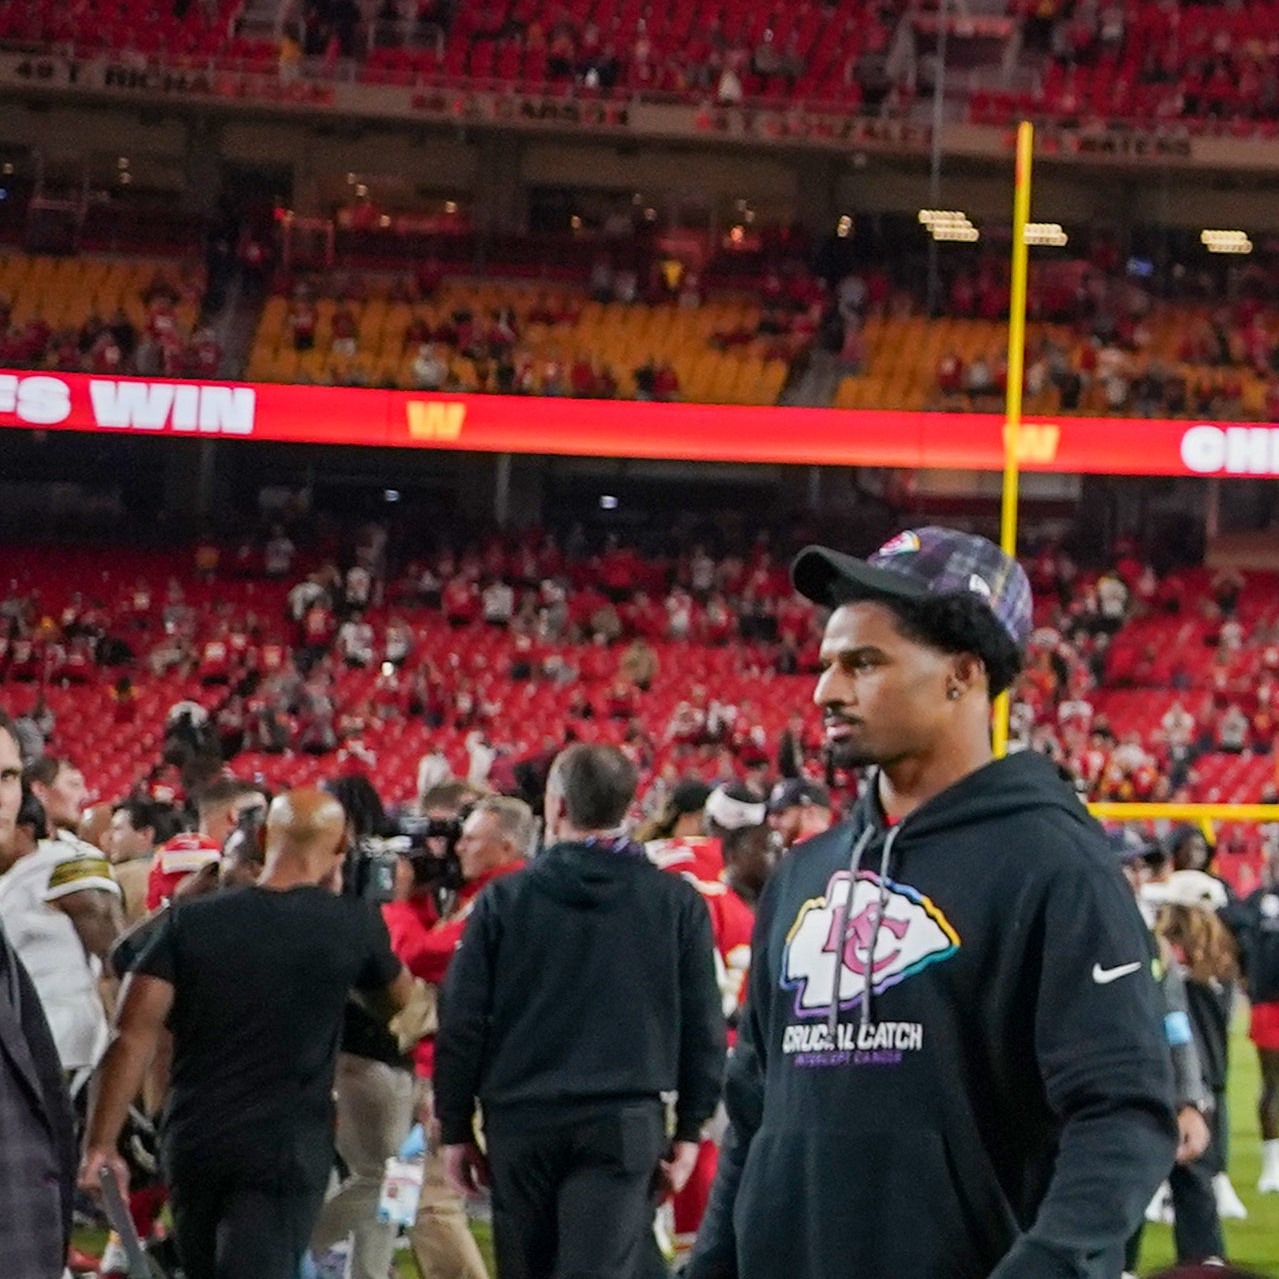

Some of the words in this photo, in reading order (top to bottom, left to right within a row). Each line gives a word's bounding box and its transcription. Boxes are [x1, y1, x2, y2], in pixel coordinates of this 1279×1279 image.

[89, 379, 256, 434] WIN
[406, 400, 466, 440] W
[821, 901, 911, 976] KC
[782, 1022, 856, 1054] CRUCL
[857, 1021, 923, 1051] CATCH
